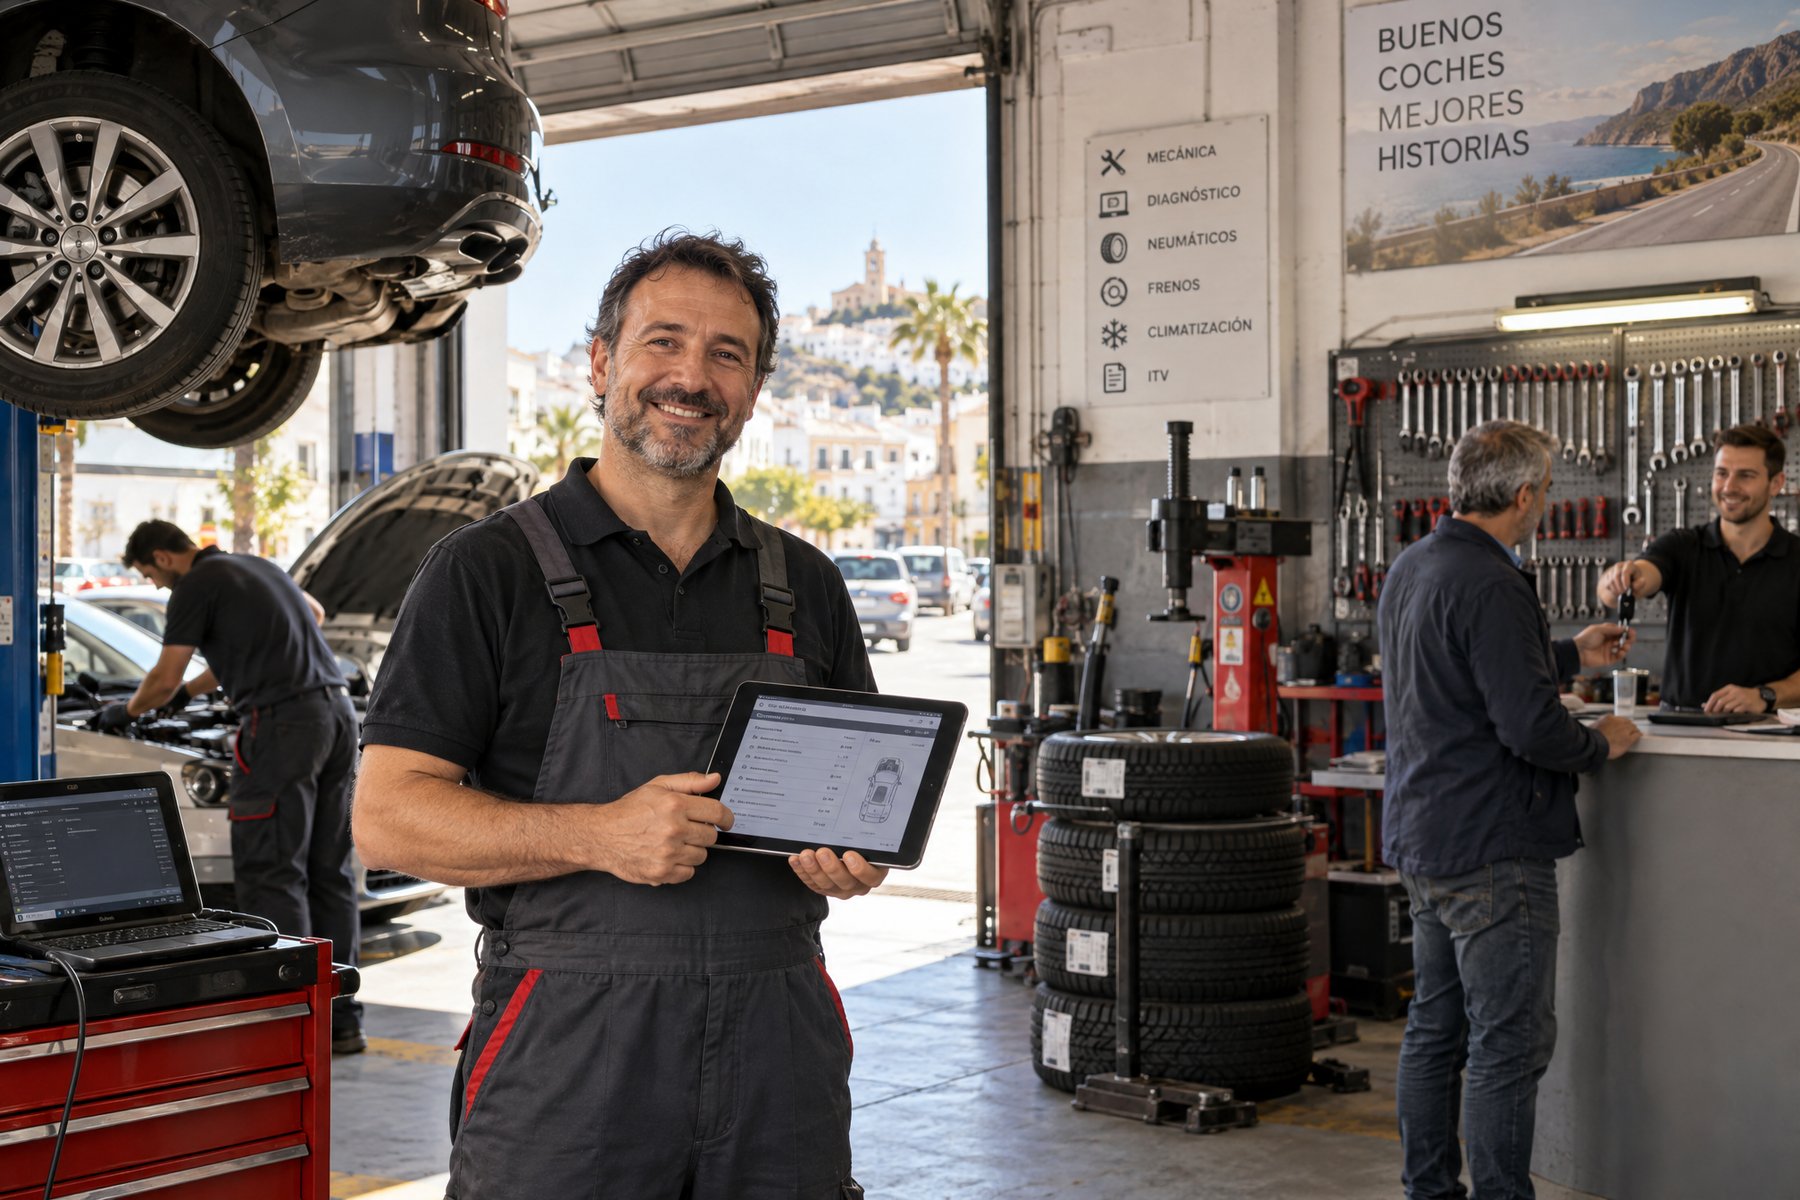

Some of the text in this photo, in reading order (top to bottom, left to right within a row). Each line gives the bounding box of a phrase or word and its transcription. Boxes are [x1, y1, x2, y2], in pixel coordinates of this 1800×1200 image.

[1379, 11, 1503, 53] BUENOS
[1378, 51, 1505, 92] COCHES
[1379, 89, 1524, 132] MEJORES
[1147, 144, 1217, 164] MECÁNICA
[1379, 129, 1530, 172] HISTORIAS
[1147, 185, 1241, 207] DIAGNÓSTICO
[1147, 230, 1238, 251] NEUMÁTICOS
[1148, 278, 1200, 294] FRENOS
[1147, 316, 1253, 338] CLIMATIZACIÓN
[1148, 369, 1169, 382] ITV
